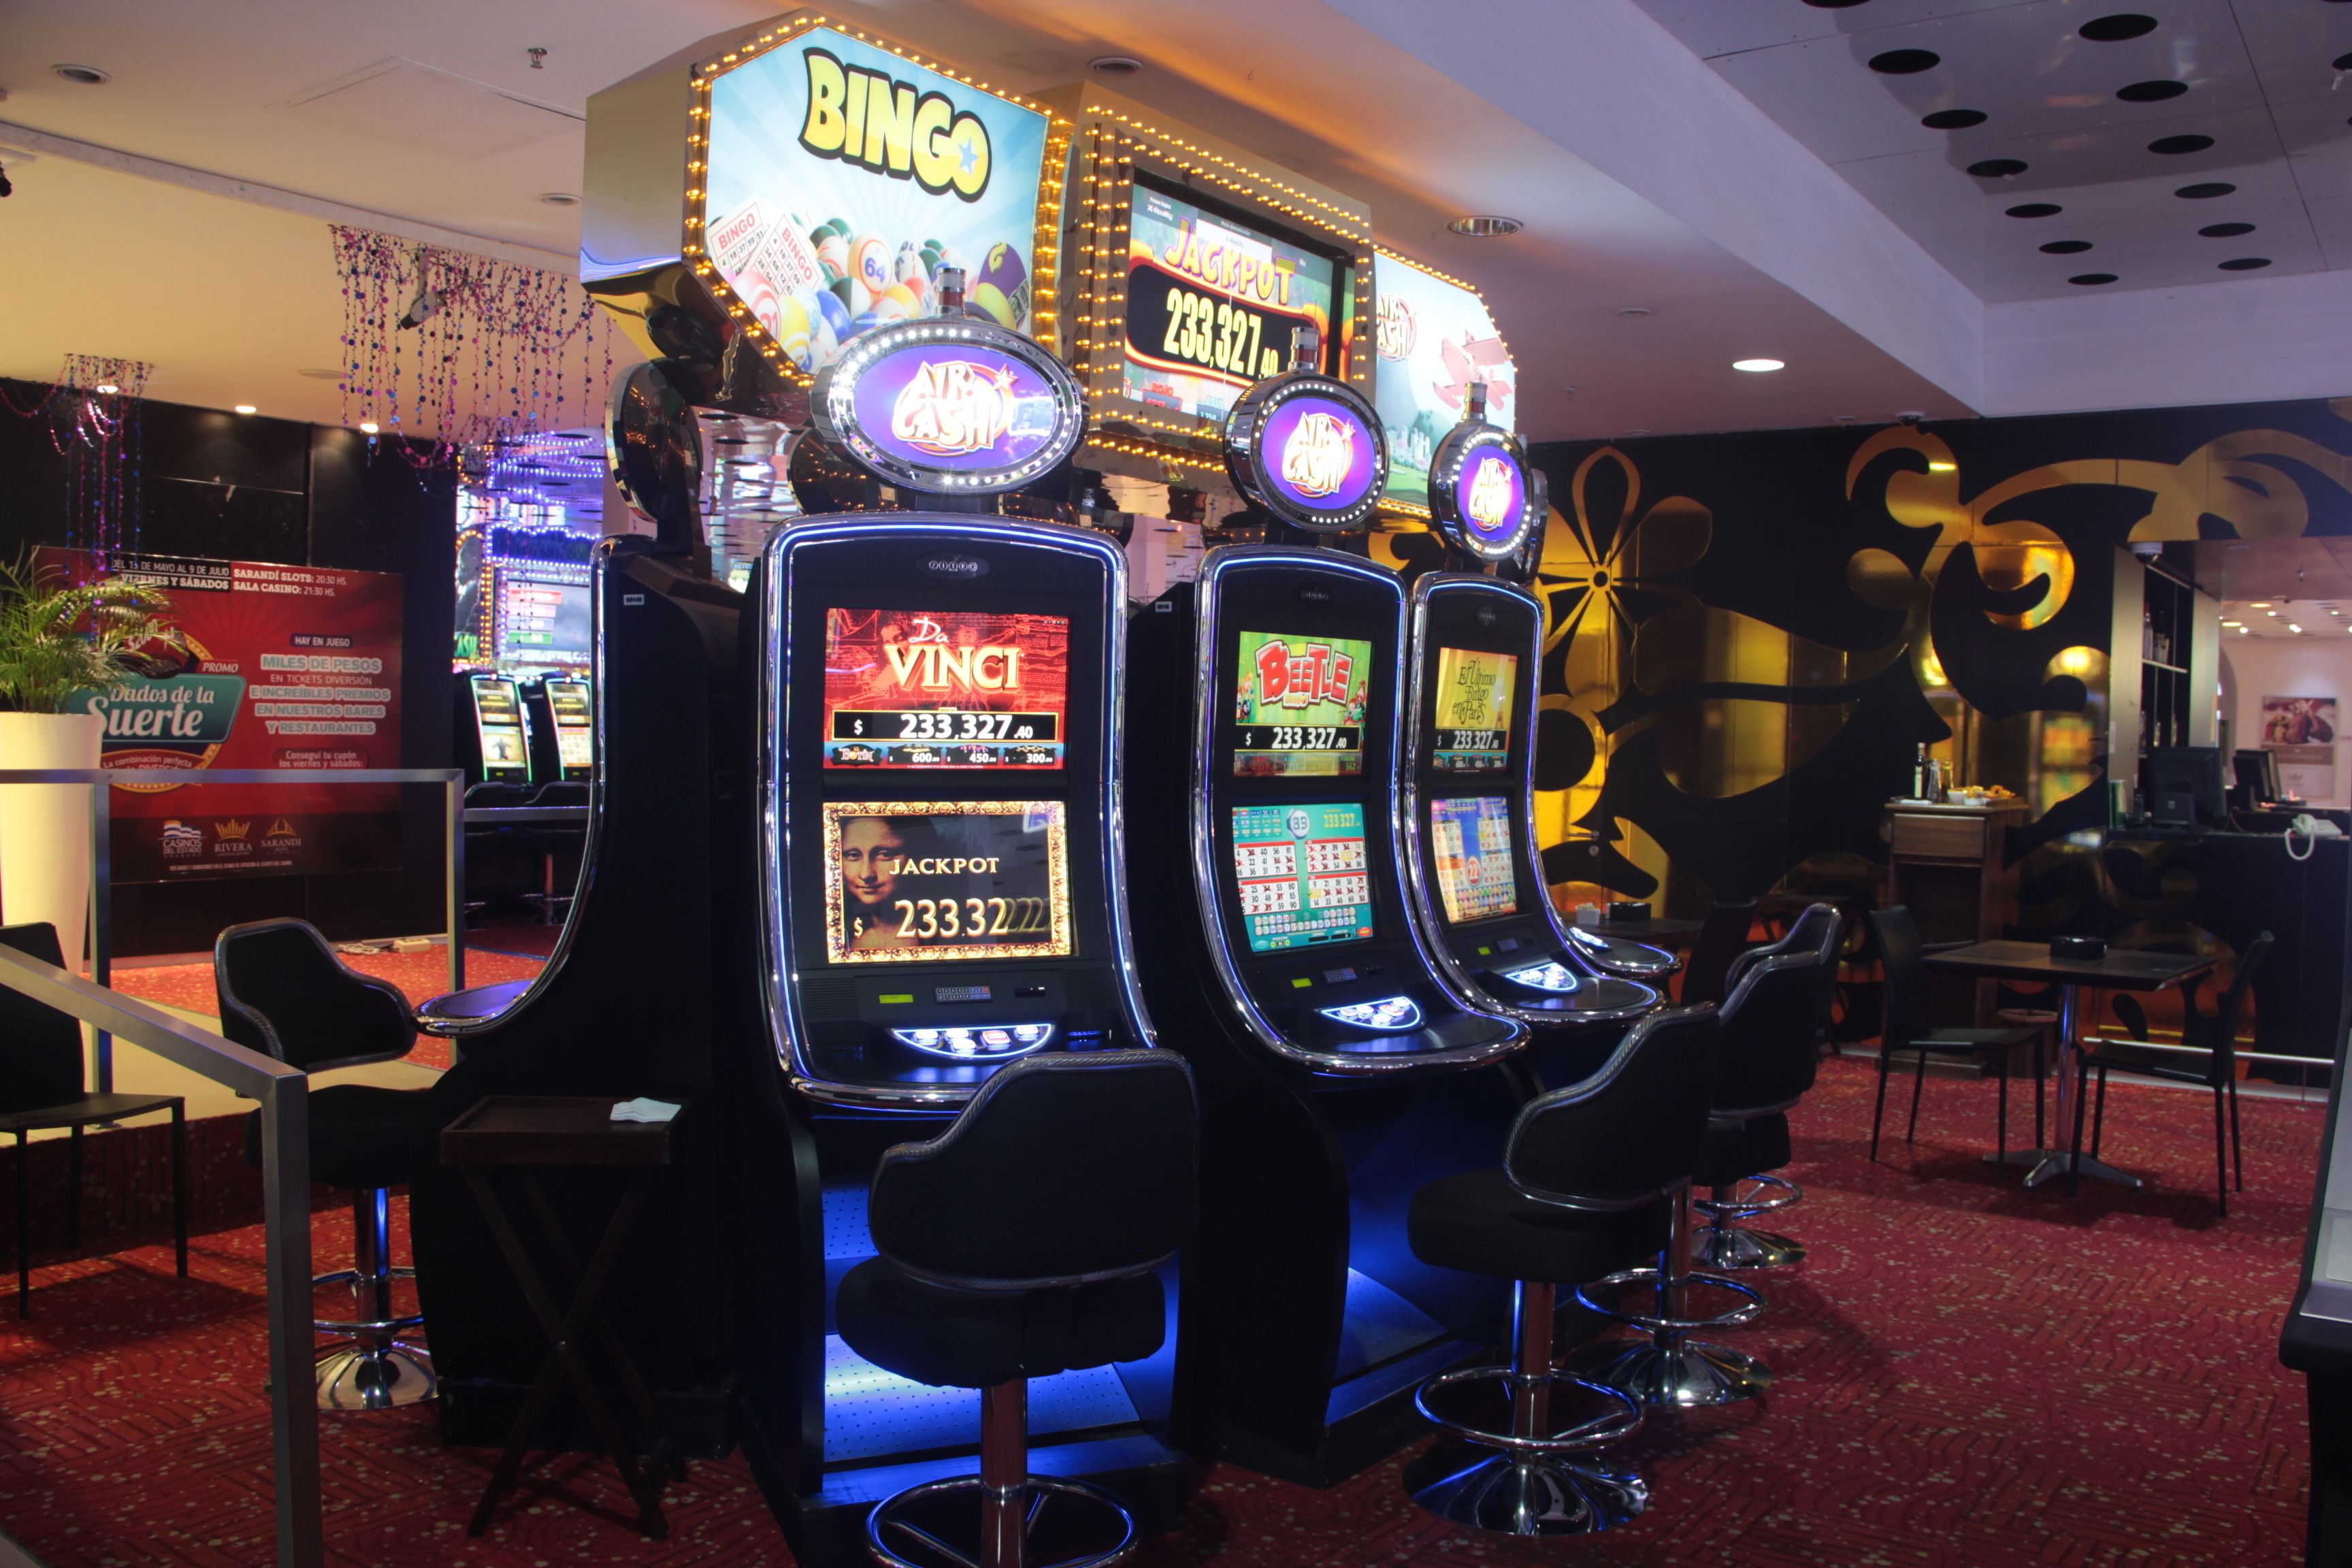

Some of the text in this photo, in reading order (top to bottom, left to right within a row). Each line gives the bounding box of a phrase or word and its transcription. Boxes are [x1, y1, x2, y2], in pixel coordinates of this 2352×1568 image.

[800, 48, 991, 201] BINGO
[718, 213, 755, 250] BINGO
[738, 244, 747, 254] 37
[747, 236, 755, 246] 59
[756, 230, 764, 240] 51
[782, 227, 812, 280] BINGO
[1164, 215, 1297, 305] JACKPOT
[1299, 258, 1306, 267] No
[779, 274, 787, 284] 12
[864, 257, 886, 283] 64
[1376, 318, 1409, 357] ASH
[914, 360, 975, 401] AIR
[893, 400, 994, 451] CASH
[1292, 412, 1333, 445] AIR
[1283, 444, 1341, 493] CASH
[1477, 457, 1502, 487] AIR
[1469, 485, 1504, 528] CASH
[141, 561, 151, 570] DE
[154, 563, 175, 572] MAYO
[177, 564, 187, 573] AL
[189, 565, 195, 574] 9
[197, 566, 207, 574] DE
[208, 566, 229, 576] JULIO
[233, 568, 348, 586] SARANDÍ SLOTS: 20:30 HS.
[169, 576, 179, 586] Y
[180, 576, 229, 589] SÁBADOS
[233, 581, 336, 597] SALA CASINO: 21:30 HS.
[908, 616, 949, 644] Da
[295, 636, 350, 647] HAY EN JUEGO
[203, 662, 239, 673] PROMO
[261, 654, 382, 673] MILES DE PESOS
[884, 643, 1024, 694] VINCI
[271, 674, 372, 685] EN TICKETS DIVERSIÓN
[1256, 640, 1354, 706] BEETLE
[171, 686, 193, 704] de
[196, 686, 215, 704] la
[250, 685, 391, 702] E INCREÍBLES PREMIOS
[1284, 694, 1308, 705] BINGO
[1465, 685, 1489, 702] Bingo
[87, 696, 203, 736] Suerte
[255, 703, 386, 719] EN NUESTROS BARES
[265, 720, 376, 735] Y RESTAURANTES
[854, 719, 863, 735] $
[1245, 732, 1252, 746] $
[1437, 734, 1441, 747] $
[103, 760, 114, 769] La
[115, 755, 161, 767] combinación
[163, 756, 192, 768] perfecta
[279, 759, 291, 767] los
[293, 759, 322, 767] viernes
[330, 758, 363, 767] sábados:
[286, 751, 321, 761] Conseguí
[333, 751, 357, 761] cupón
[163, 838, 202, 848] CASINOS
[214, 843, 252, 852] RIVERA
[889, 856, 1000, 876] JACKPOT
[853, 915, 863, 940] $
